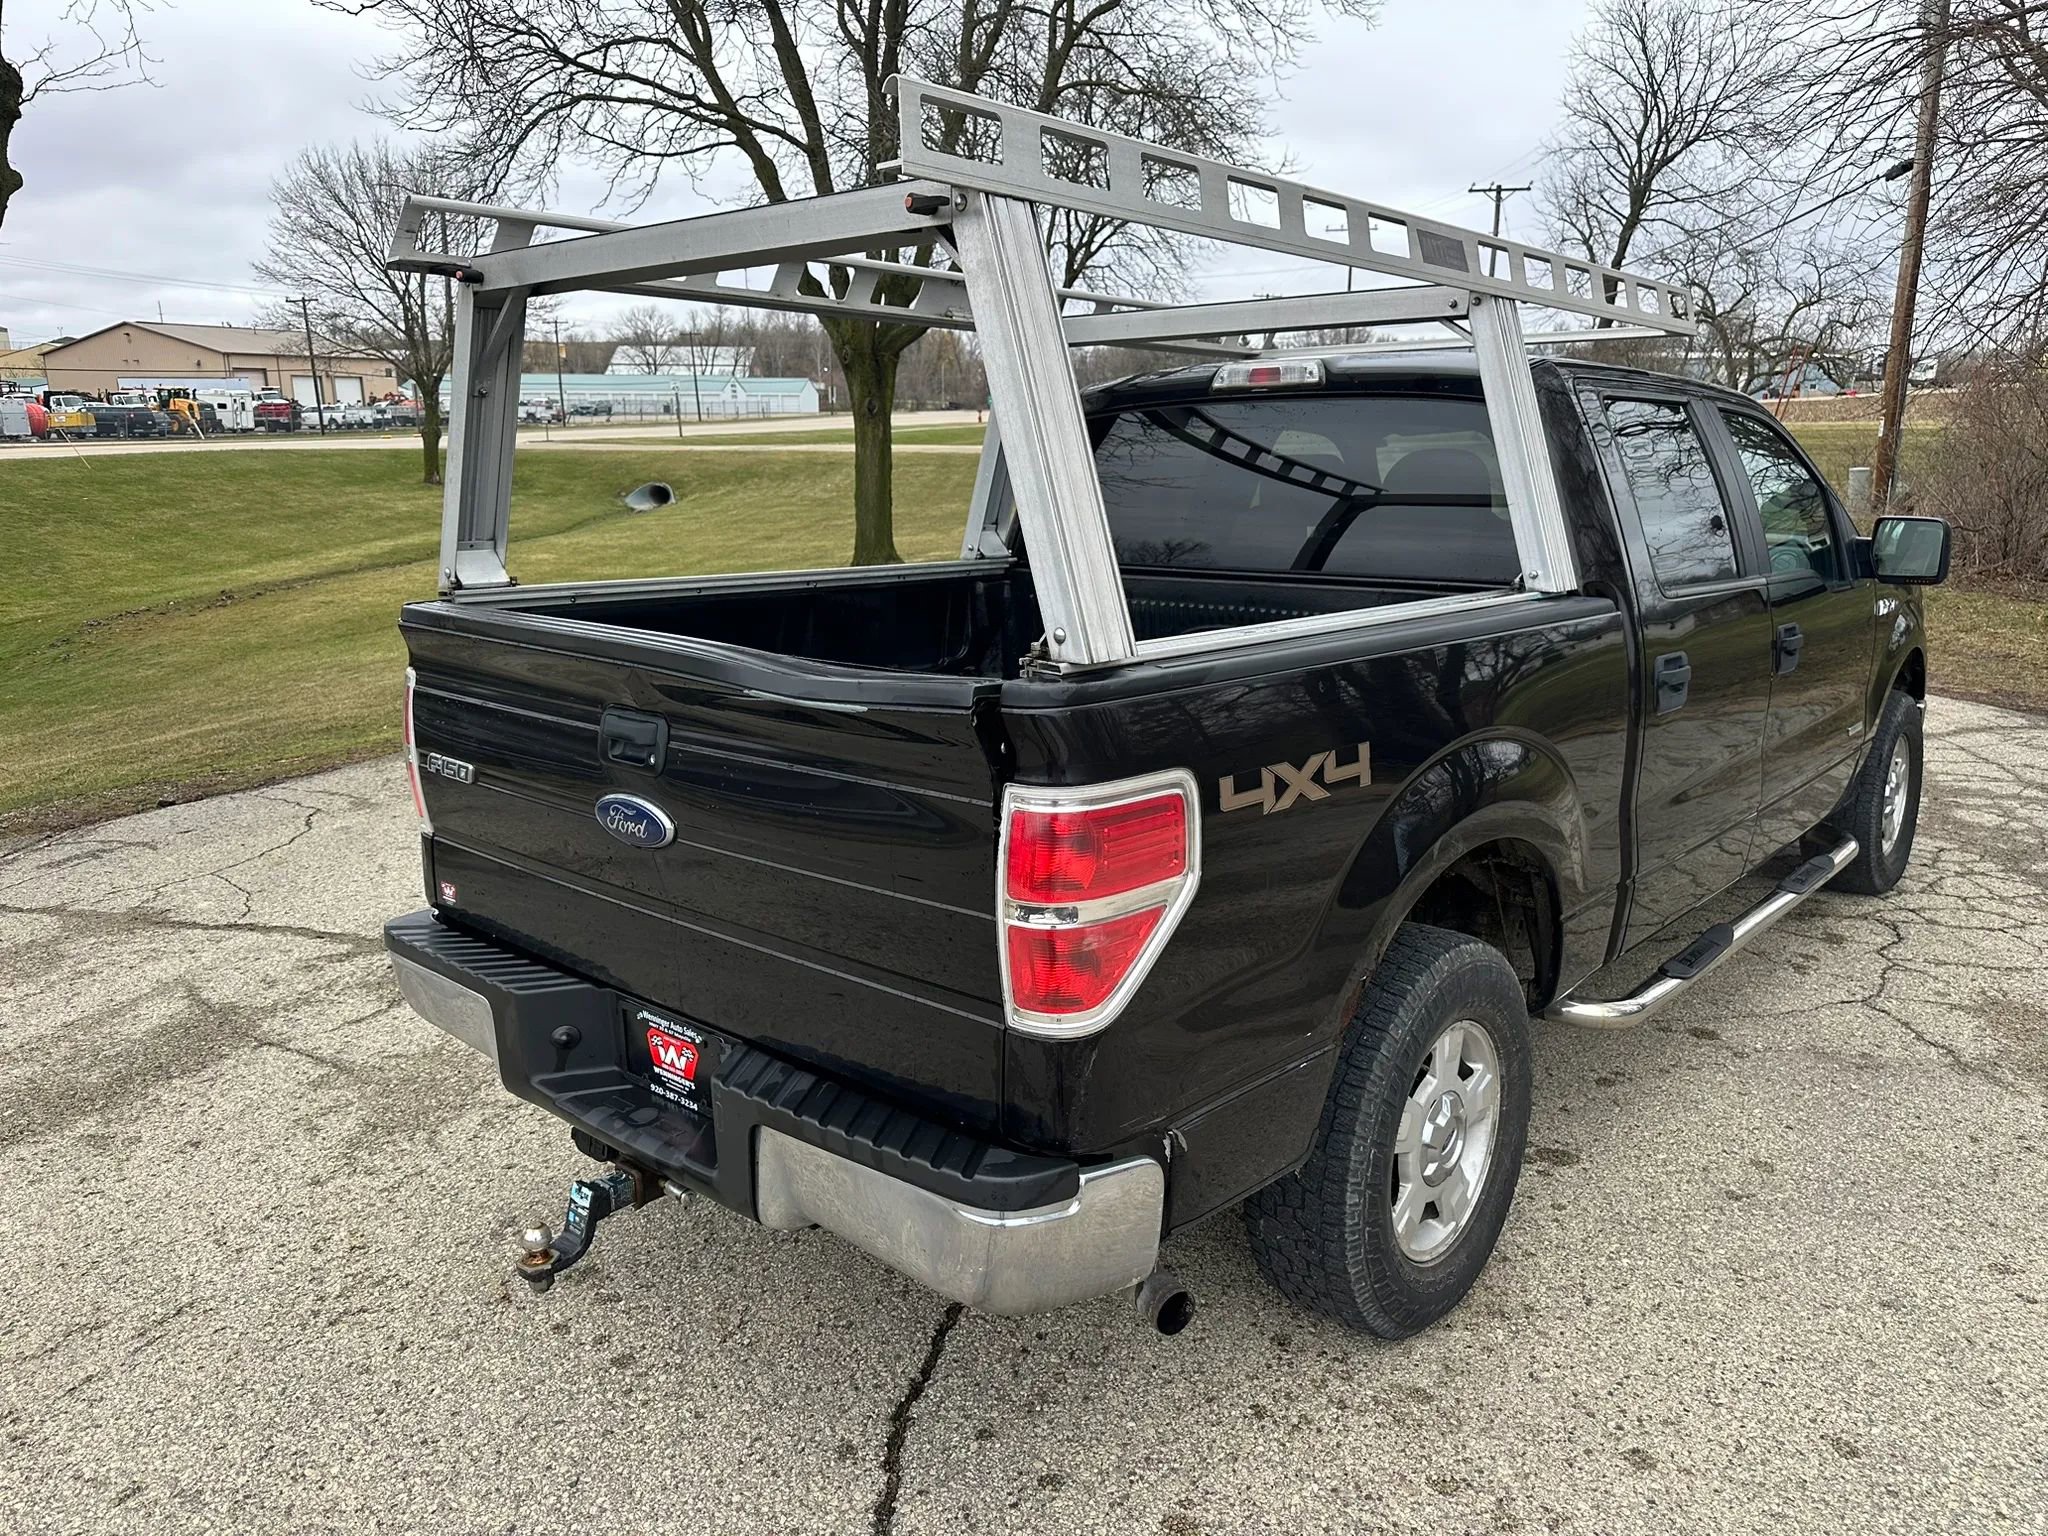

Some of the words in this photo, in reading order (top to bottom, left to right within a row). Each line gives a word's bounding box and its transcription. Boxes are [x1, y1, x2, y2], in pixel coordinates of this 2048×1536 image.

[606, 804, 648, 839] Ford
[642, 1010, 670, 1028] Wenninger
[670, 1021, 683, 1034] Auto
[684, 1026, 698, 1039] Sales
[650, 1083, 699, 1111] 920-387-3234
